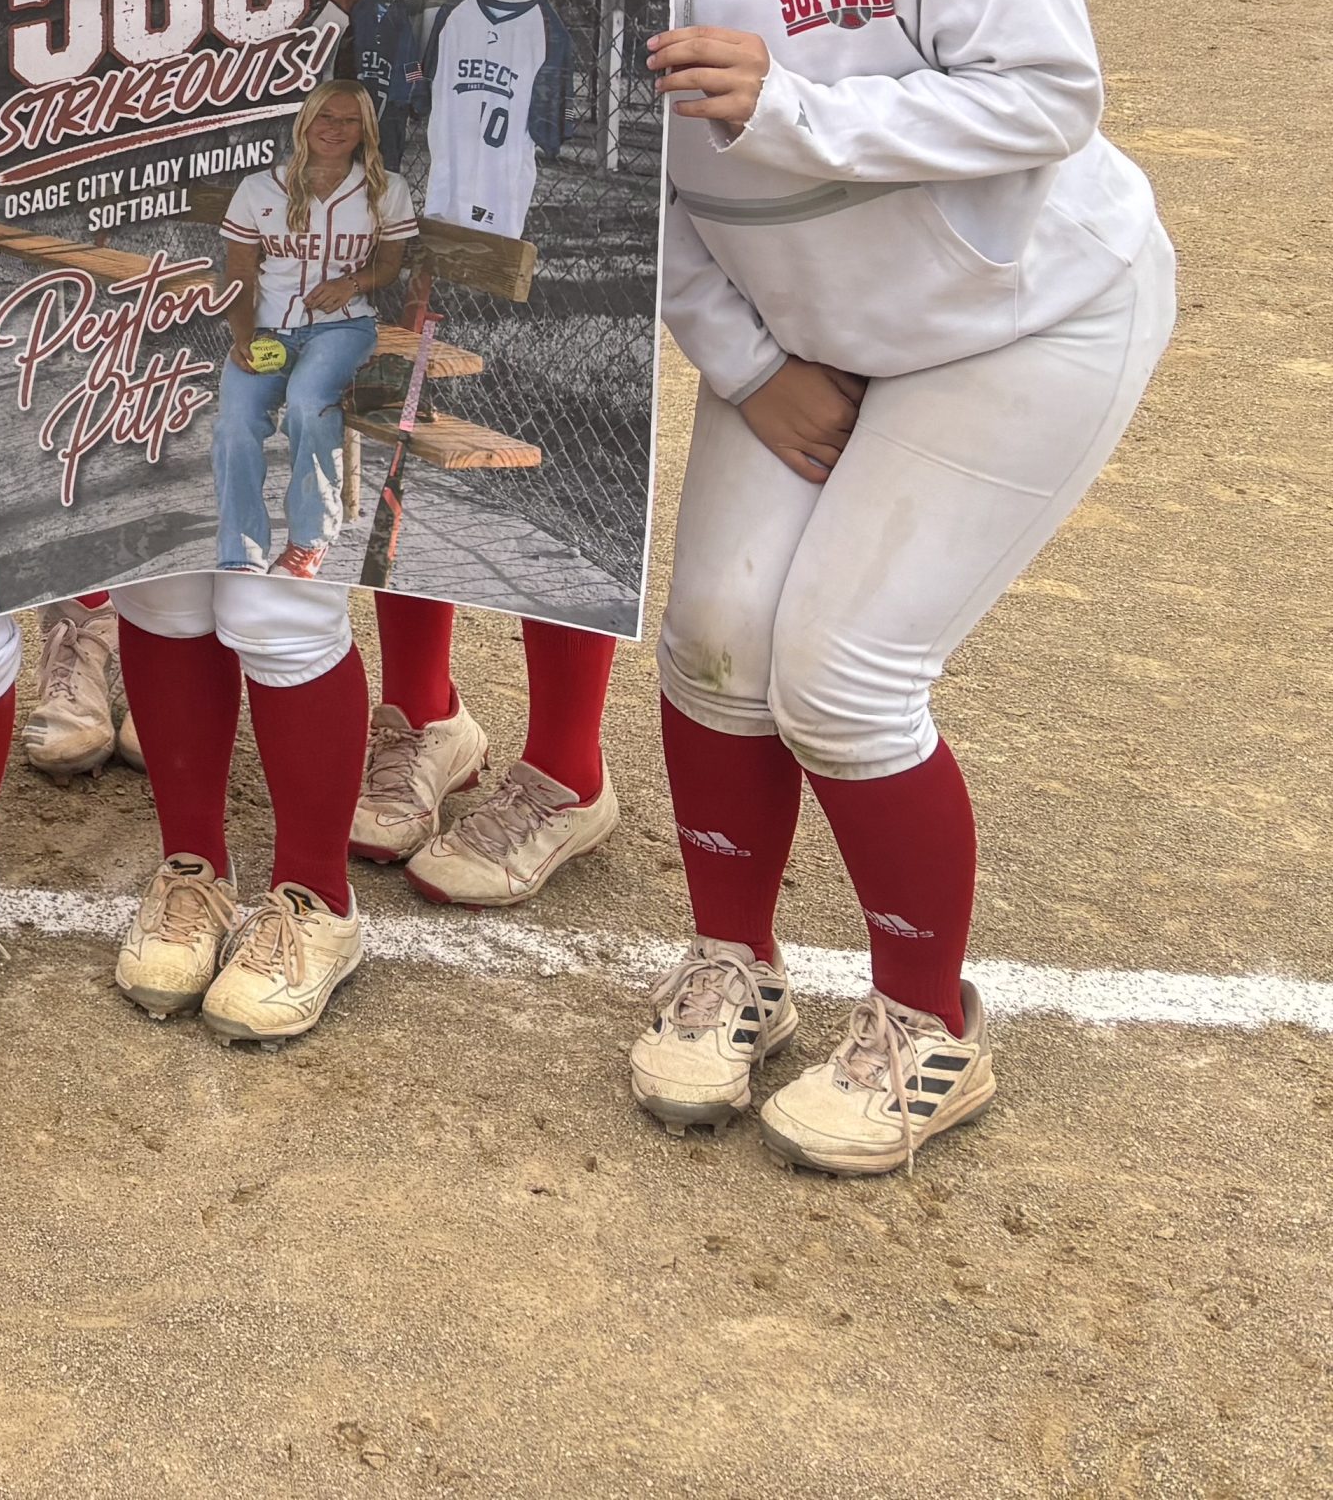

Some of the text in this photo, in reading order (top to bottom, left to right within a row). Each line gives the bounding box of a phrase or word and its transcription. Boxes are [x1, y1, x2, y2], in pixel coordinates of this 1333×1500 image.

[4, 139, 275, 220] OSAGE CITY LADY INDIANS
[88, 189, 192, 232] SOFTBALL
[38, 348, 213, 507] Pitts
[866, 911, 935, 938] didas
